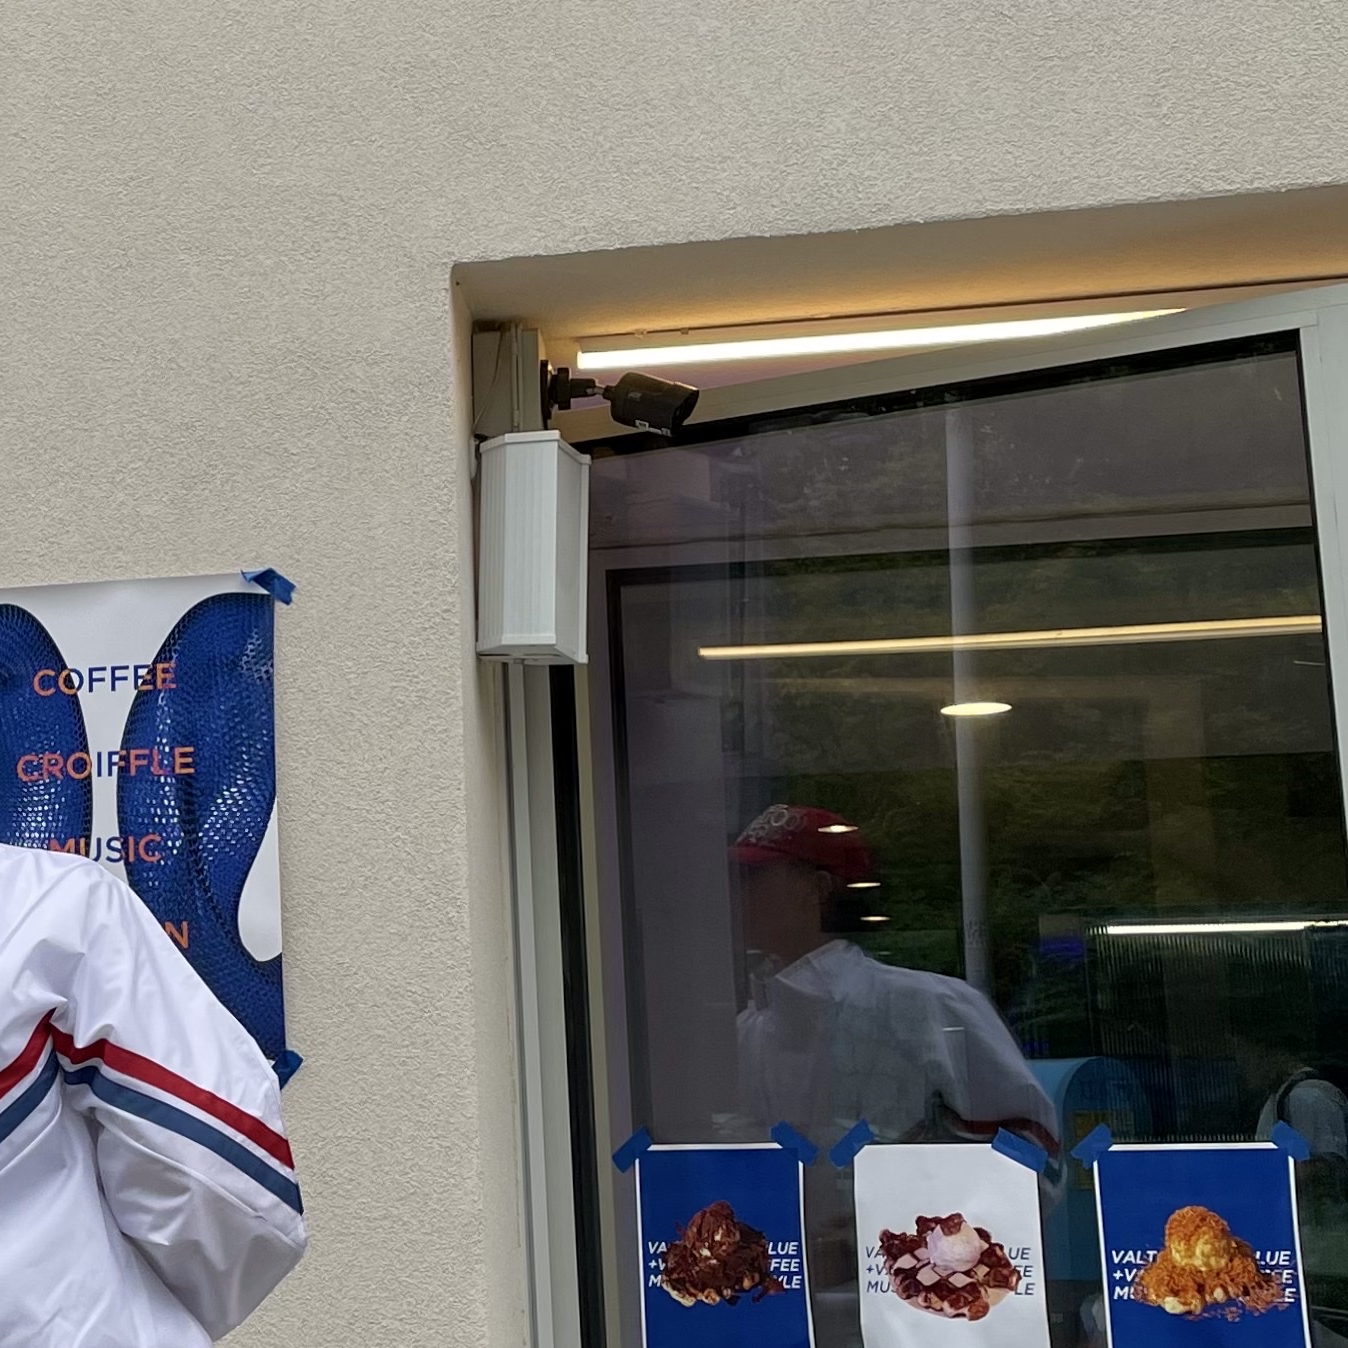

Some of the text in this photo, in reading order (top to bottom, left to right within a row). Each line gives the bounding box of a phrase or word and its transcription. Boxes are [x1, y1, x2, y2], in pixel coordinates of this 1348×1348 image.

[32, 662, 177, 696] COFFEE
[16, 747, 195, 782] CROIFFLE
[648, 1242, 799, 1256] VA LUE
[1255, 1251, 1292, 1265] LUE
